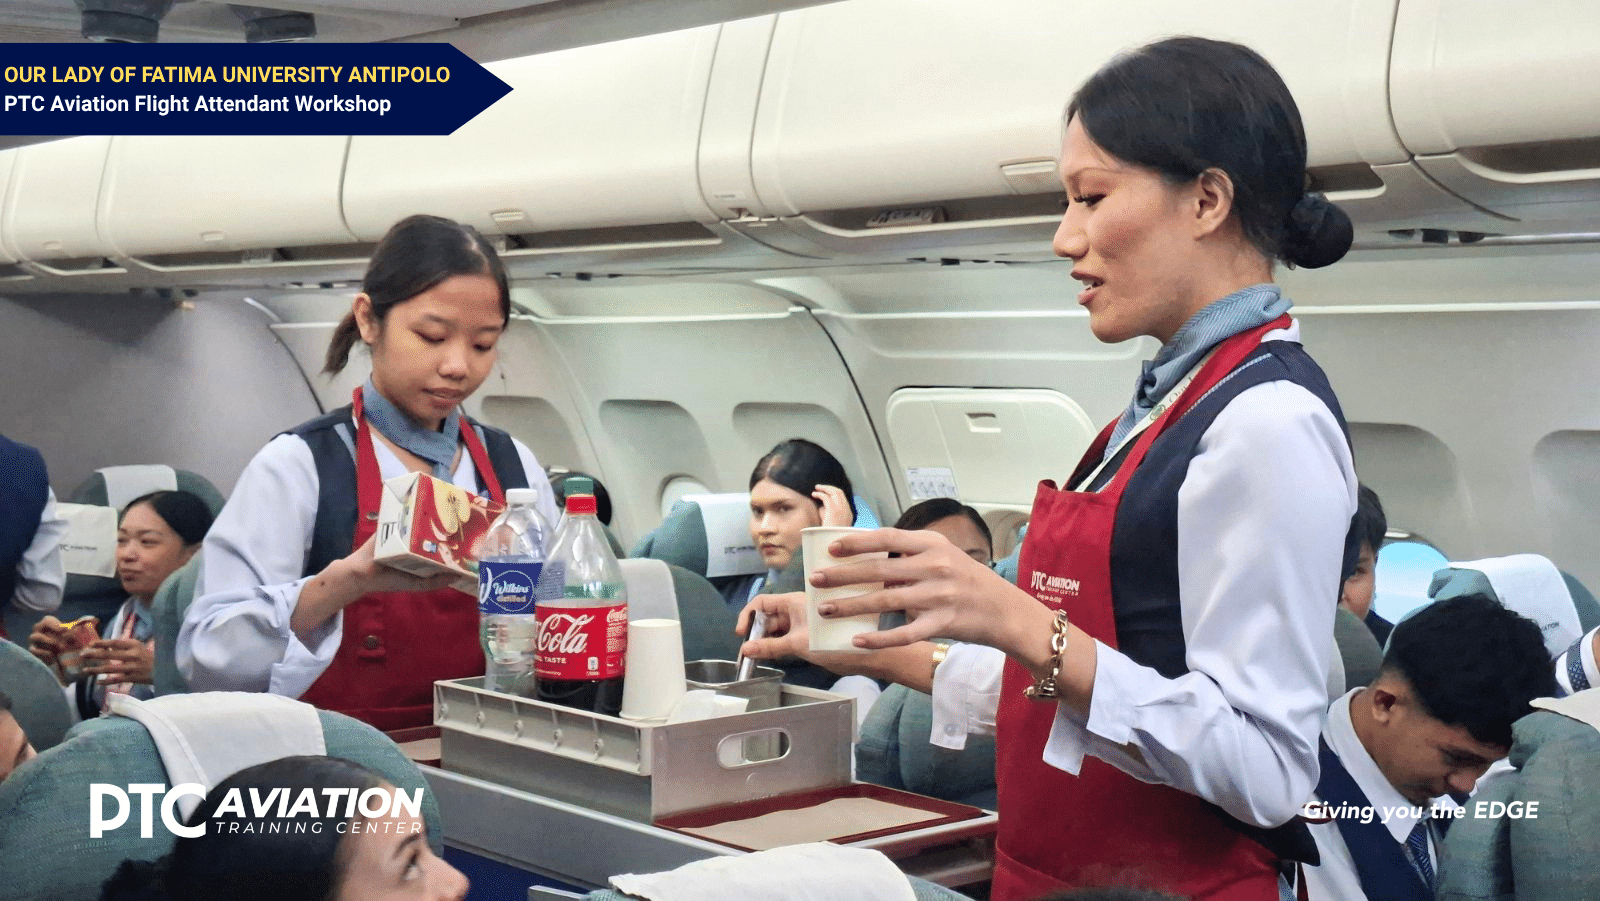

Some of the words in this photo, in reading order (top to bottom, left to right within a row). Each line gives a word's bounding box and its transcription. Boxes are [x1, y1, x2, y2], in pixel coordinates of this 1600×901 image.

[493, 580, 530, 595] Wilkins
[1031, 570, 1047, 591] PTC
[538, 613, 595, 654] Cola
[544, 656, 567, 664] TASTE
